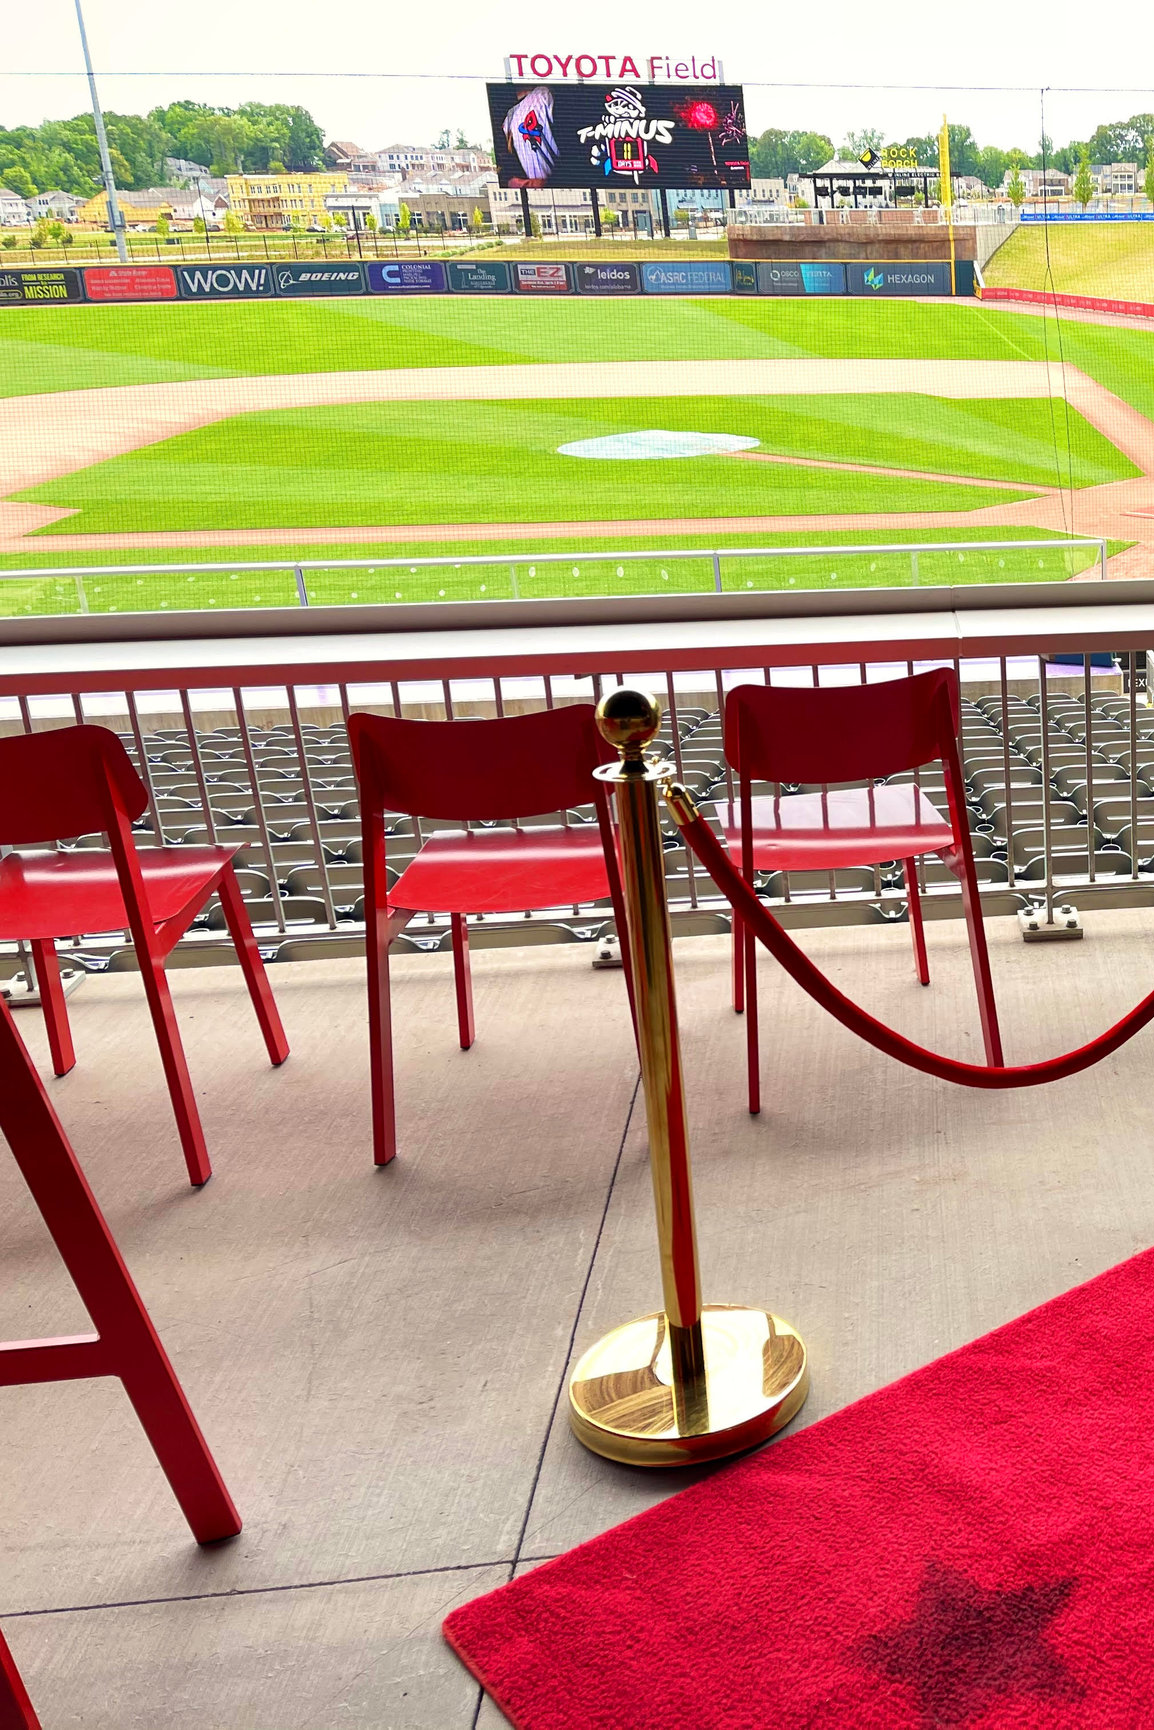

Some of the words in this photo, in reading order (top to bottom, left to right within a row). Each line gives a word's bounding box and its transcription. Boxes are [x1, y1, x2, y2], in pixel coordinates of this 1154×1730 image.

[510, 54, 641, 78] TOYOTA
[650, 56, 718, 80] Field
[577, 119, 676, 144] T-MINUS
[881, 148, 918, 158] ROCK
[881, 160, 918, 169] PORCH
[37, 273, 65, 281] RESEARCH
[298, 272, 360, 281] BOEING
[536, 267, 562, 278] EZ
[598, 269, 630, 279] leidos
[660, 271, 686, 283] ASRC
[688, 271, 726, 283] FEDERAL
[183, 269, 266, 293] WOW!
[887, 274, 935, 283] HEXAGON
[24, 285, 68, 299] MISSION
